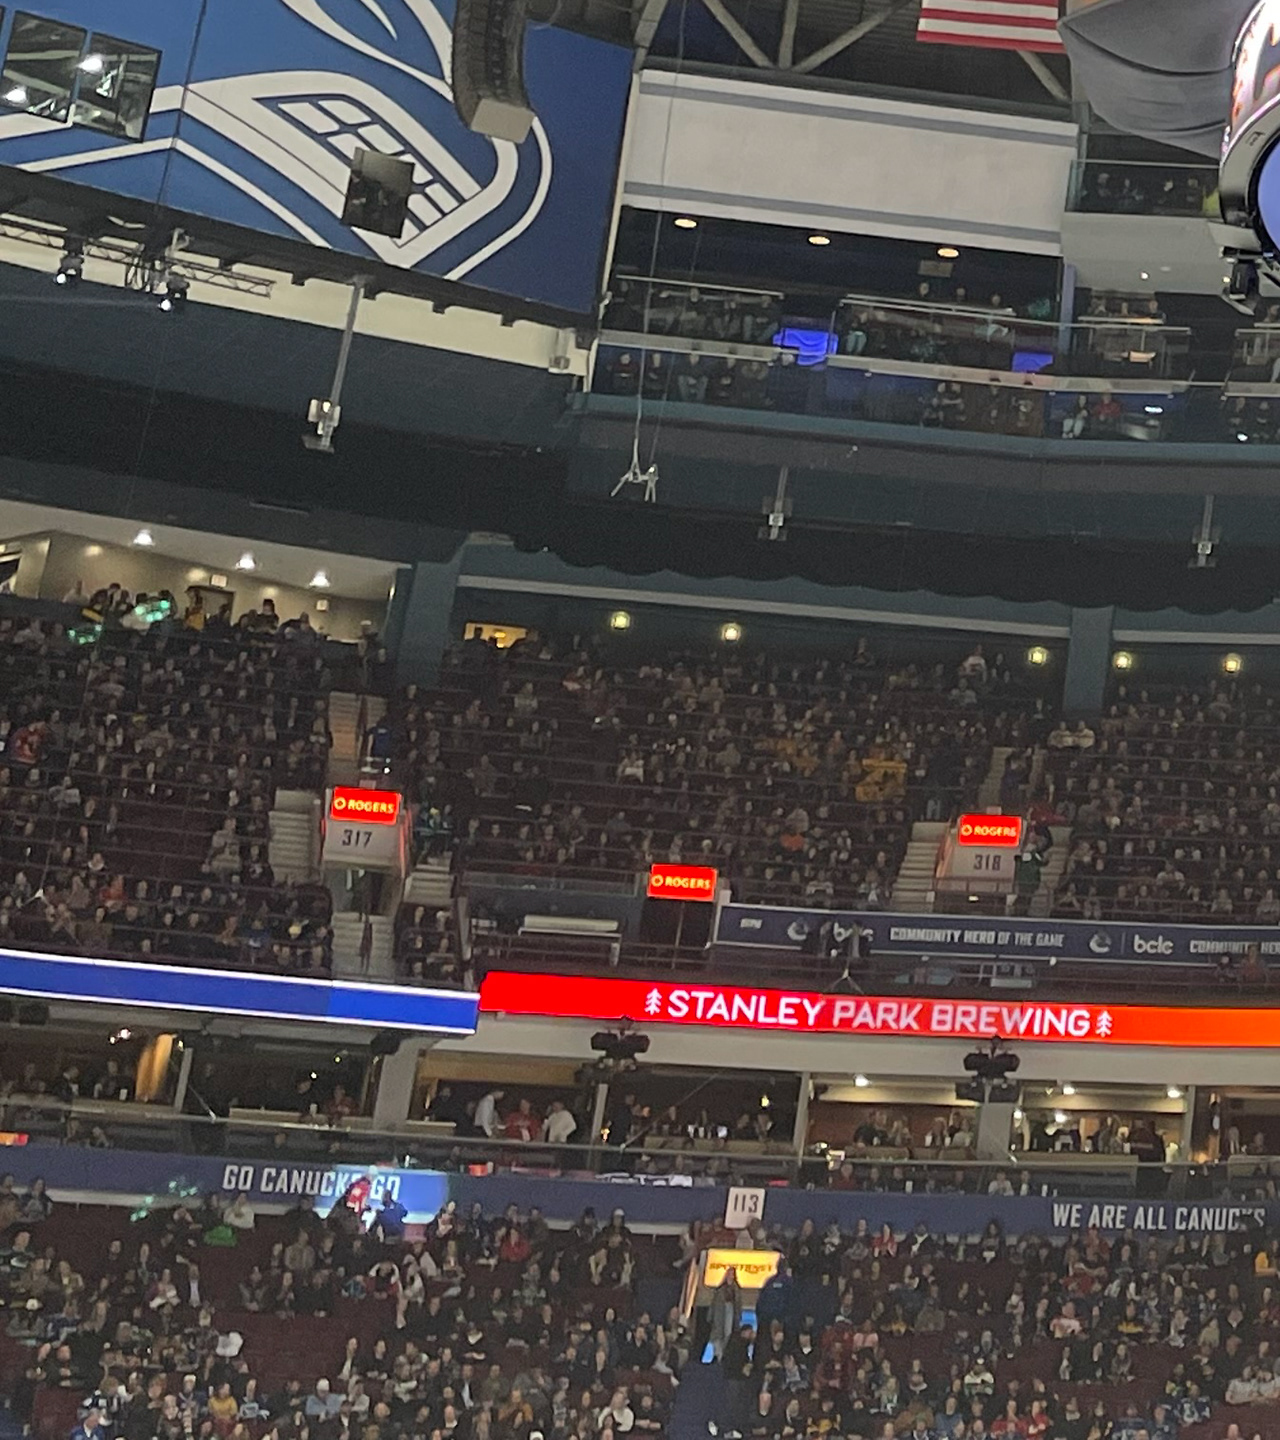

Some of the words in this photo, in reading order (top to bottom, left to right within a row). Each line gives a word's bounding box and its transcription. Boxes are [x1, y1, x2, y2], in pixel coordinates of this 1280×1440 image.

[348, 799, 395, 814] ROGERS
[342, 828, 373, 849] 317
[974, 825, 1017, 837] ROGERS
[974, 854, 1001, 871] 318
[665, 875, 711, 890] ROGERS
[890, 926, 960, 943] COMMUNITY
[964, 929, 996, 945] HERO
[998, 931, 1011, 945] OF
[1014, 932, 1034, 946] THE
[1036, 933, 1064, 947] GAME
[1133, 934, 1175, 955] bclc
[667, 989, 822, 1026] STANLEY
[833, 1001, 922, 1031] PARK
[931, 1006, 1091, 1037] BREWING
[222, 1164, 254, 1191] GO
[734, 1193, 759, 1213] 113
[1053, 1203, 1085, 1230] WE
[1089, 1204, 1128, 1230] ARE
[1134, 1205, 1168, 1231] ALL
